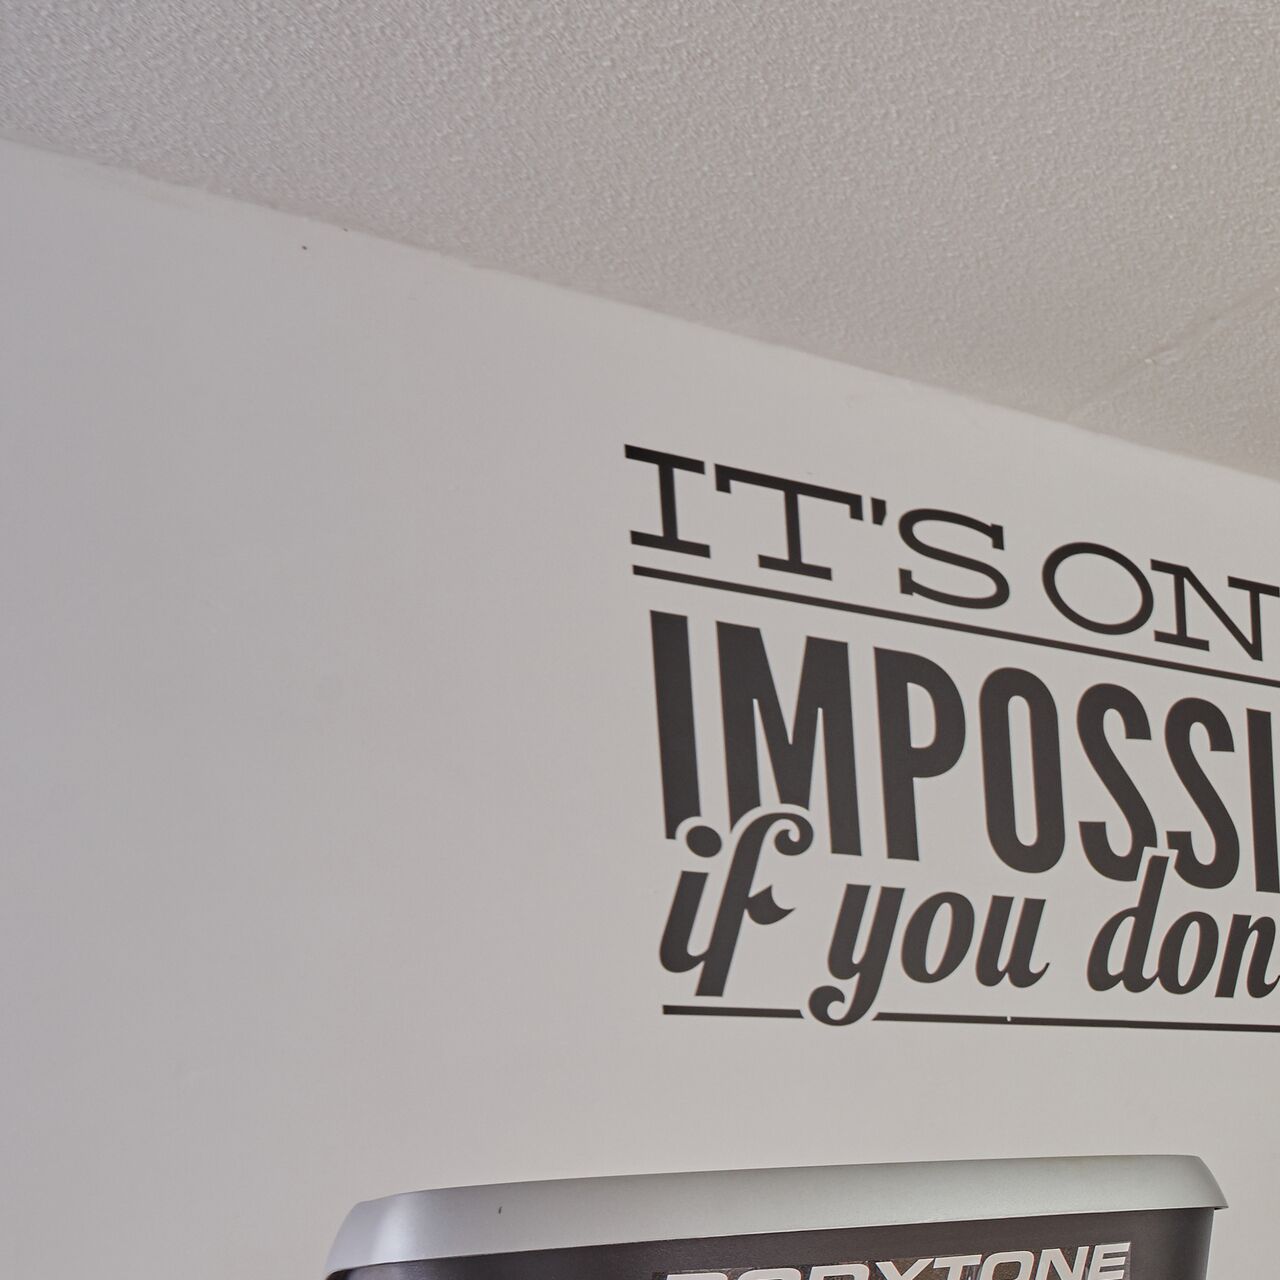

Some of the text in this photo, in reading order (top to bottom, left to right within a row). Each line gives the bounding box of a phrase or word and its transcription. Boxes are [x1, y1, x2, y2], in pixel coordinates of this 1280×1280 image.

[624, 443, 1011, 610] IT'S
[657, 811, 816, 999] if
[807, 884, 1050, 1027] you
